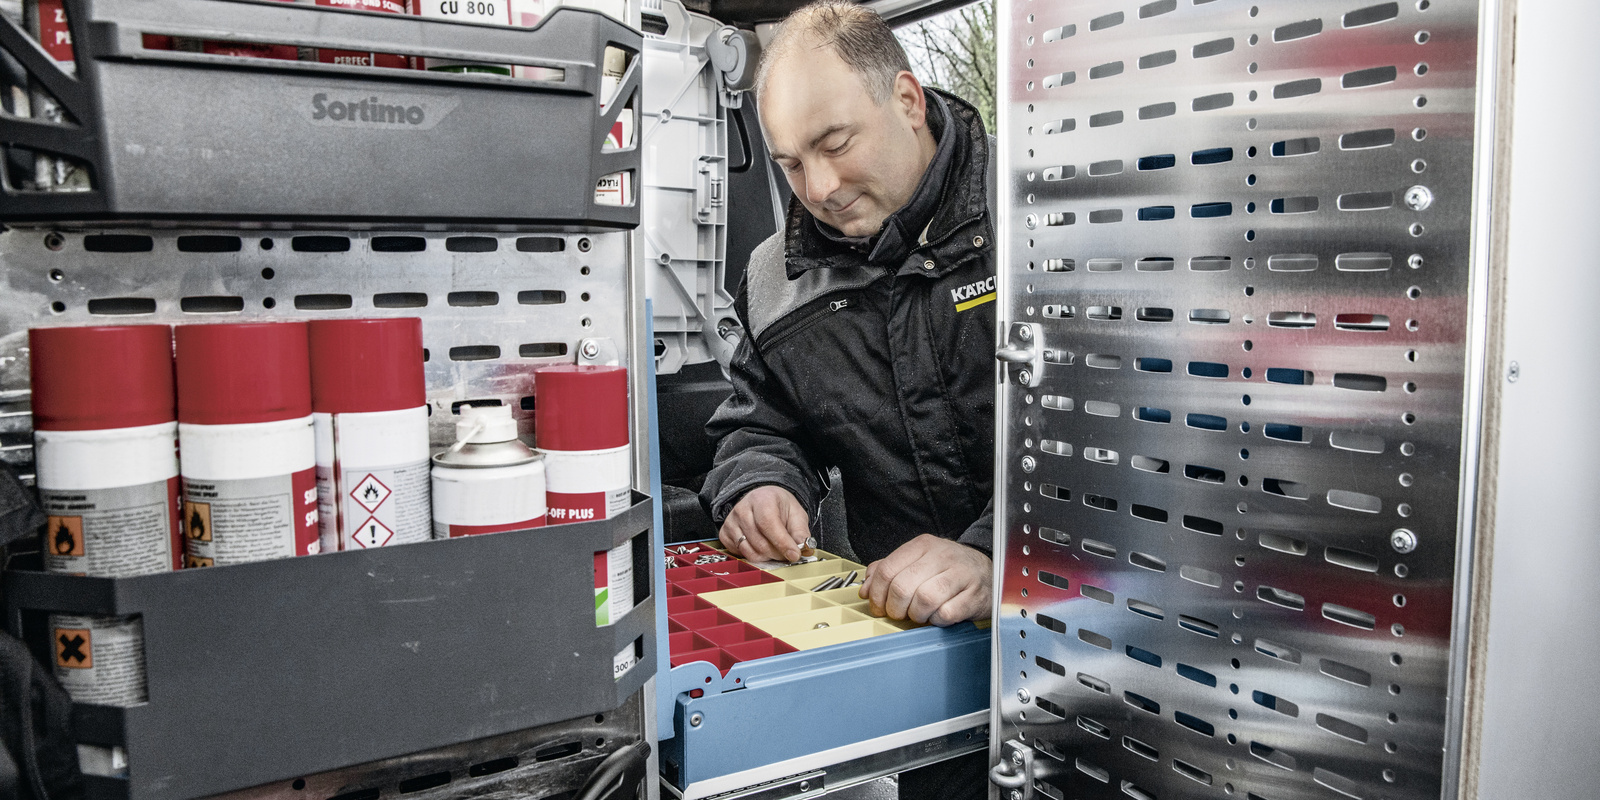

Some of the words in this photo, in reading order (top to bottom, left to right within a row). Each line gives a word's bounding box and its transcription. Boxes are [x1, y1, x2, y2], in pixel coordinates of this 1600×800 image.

[440, 1, 458, 15] CU
[467, 1, 495, 16] 800
[334, 56, 369, 66] PERFEC
[312, 92, 425, 126] Sortimo
[568, 508, 594, 520] PLUS
[614, 661, 629, 673] 300
